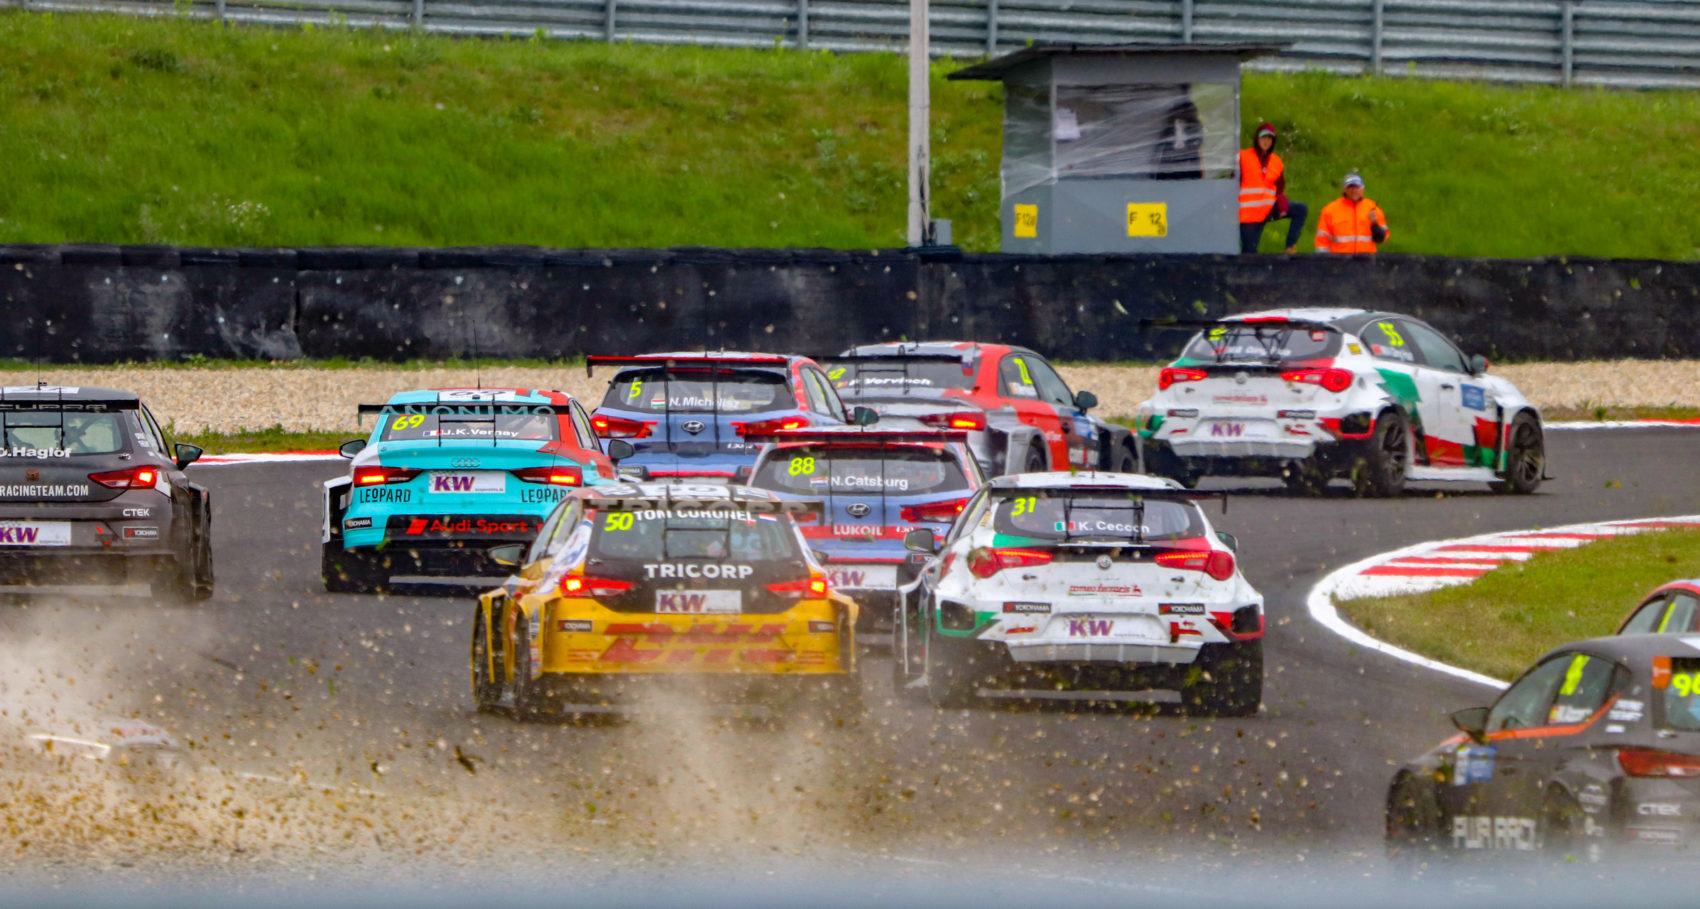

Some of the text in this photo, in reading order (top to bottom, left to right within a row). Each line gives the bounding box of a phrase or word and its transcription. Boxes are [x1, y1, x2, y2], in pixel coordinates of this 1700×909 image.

[1129, 211, 1137, 224] F
[1378, 322, 1404, 347] 55
[629, 381, 642, 398] 5
[682, 396, 740, 408] Michlisz
[379, 406, 556, 416] ANONIMO
[391, 414, 425, 431] 69
[1211, 423, 1245, 437] KW
[788, 457, 815, 476] 88
[0, 484, 89, 497] RACINGTEAM.COM
[434, 476, 475, 491] KW
[359, 488, 411, 504] LEOPARD
[520, 488, 573, 503] LEOPAR
[122, 507, 150, 517] CTEK
[1010, 496, 1036, 516] 31
[604, 512, 634, 531] 50
[634, 509, 672, 521] TOM
[430, 519, 528, 534] Audi Sport
[833, 525, 883, 536] LUKOIL
[1078, 521, 1093, 531] K.
[0, 527, 40, 543] KW
[644, 564, 754, 579] TRICORP
[659, 594, 707, 612] KW
[1015, 604, 1051, 612] YOKOHAMA
[1170, 605, 1204, 613] YOKOHAMA
[1070, 620, 1114, 636] KW
[1637, 803, 1681, 815] CTEK
